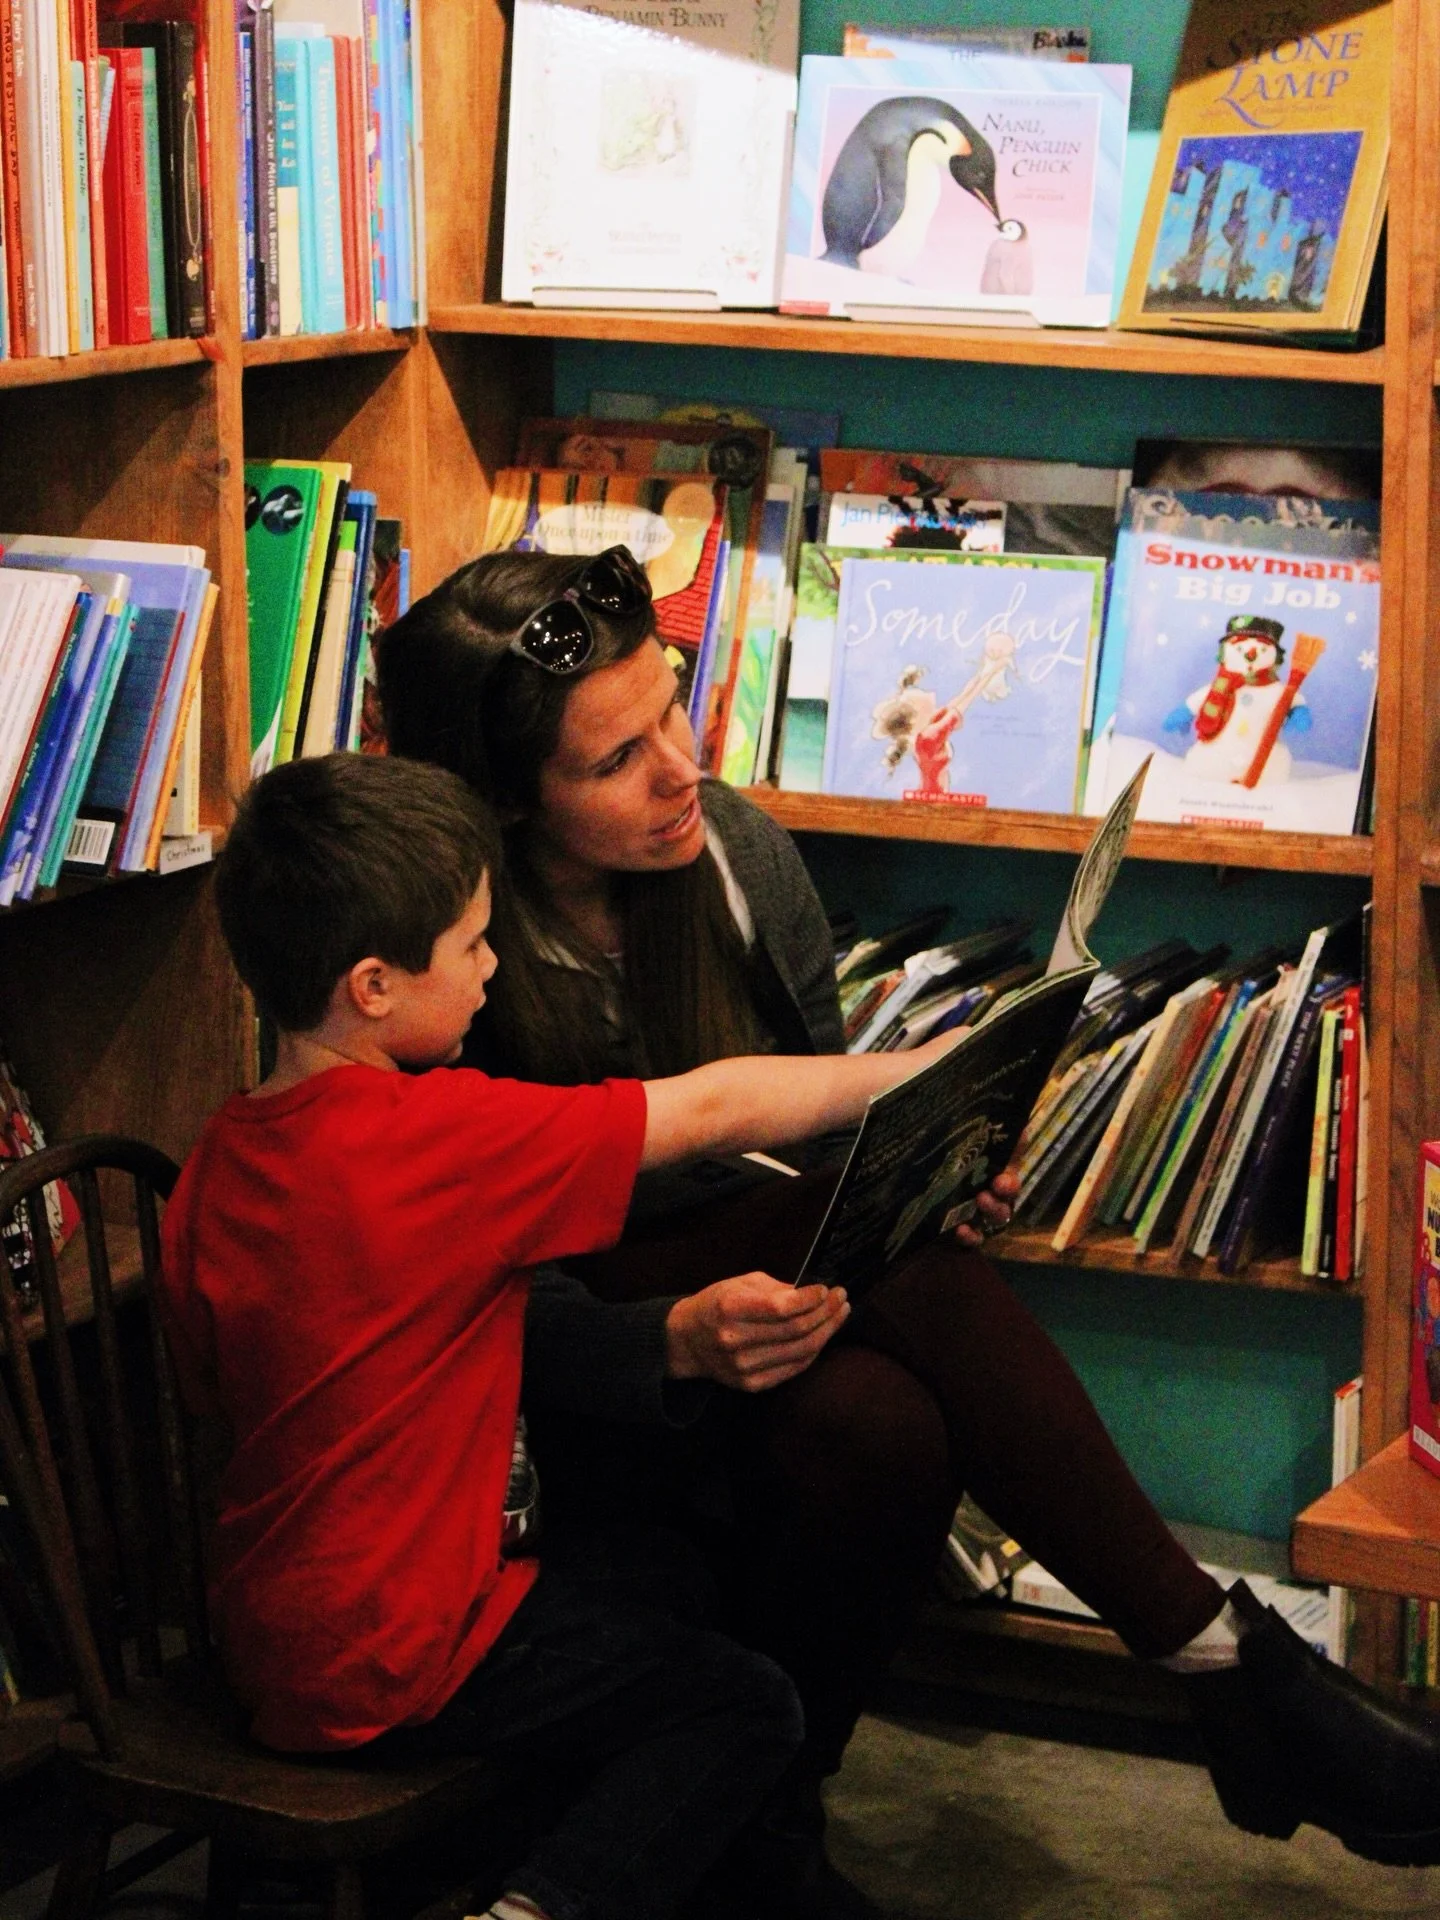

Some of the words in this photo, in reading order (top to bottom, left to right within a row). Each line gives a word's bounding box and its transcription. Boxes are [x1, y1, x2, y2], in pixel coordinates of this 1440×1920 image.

[1214, 64, 1349, 129] LAMP
[982, 112, 1045, 134] NANU,
[266, 131, 275, 158] One
[999, 136, 1082, 154] PENGUIN
[267, 162, 276, 209] Minute
[1012, 159, 1072, 178] CHICK
[269, 231, 278, 285] Bedtime
[841, 501, 872, 526] Jan
[1145, 542, 1381, 584] Snowman's
[1175, 574, 1252, 607] Big
[1263, 581, 1342, 610] Job
[845, 579, 1086, 684] Someday
